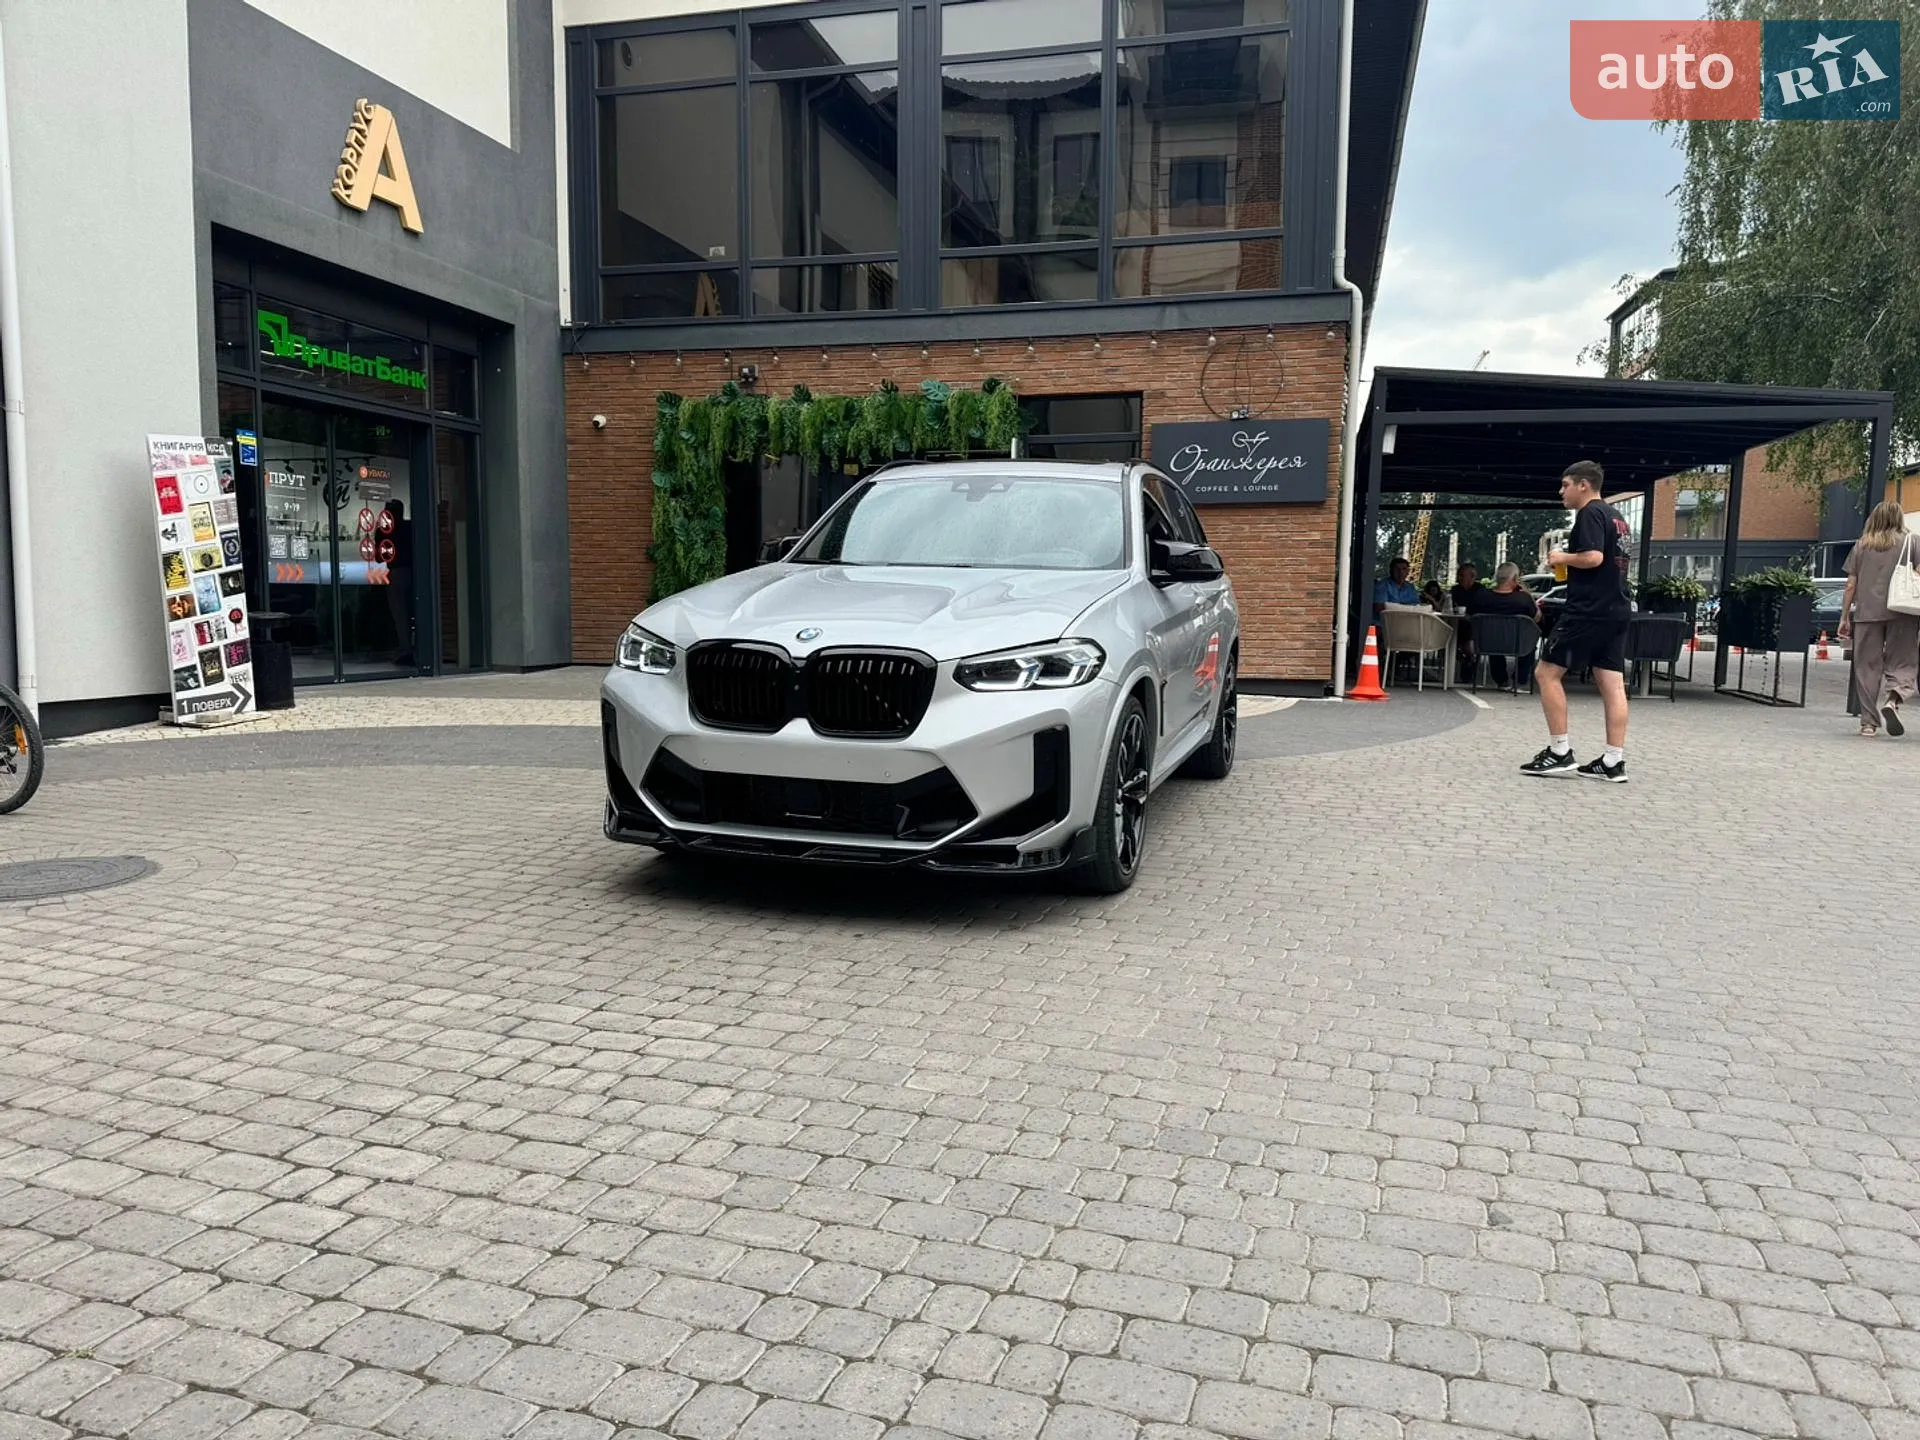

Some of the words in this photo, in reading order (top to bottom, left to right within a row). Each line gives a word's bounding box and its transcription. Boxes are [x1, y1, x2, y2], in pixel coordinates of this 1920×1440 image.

[331, 98, 375, 203] КОРПУС
[288, 334, 428, 390] ПриватБанк
[152, 441, 205, 452] КНИГАРНЯ
[1170, 443, 1308, 485] Оранжерея
[269, 471, 306, 487] ПРУТ
[1195, 485, 1229, 493] COFFEE
[1243, 484, 1279, 492] LOUNGE
[181, 700, 188, 713] 1
[191, 697, 232, 712] ПОВЕРХ
